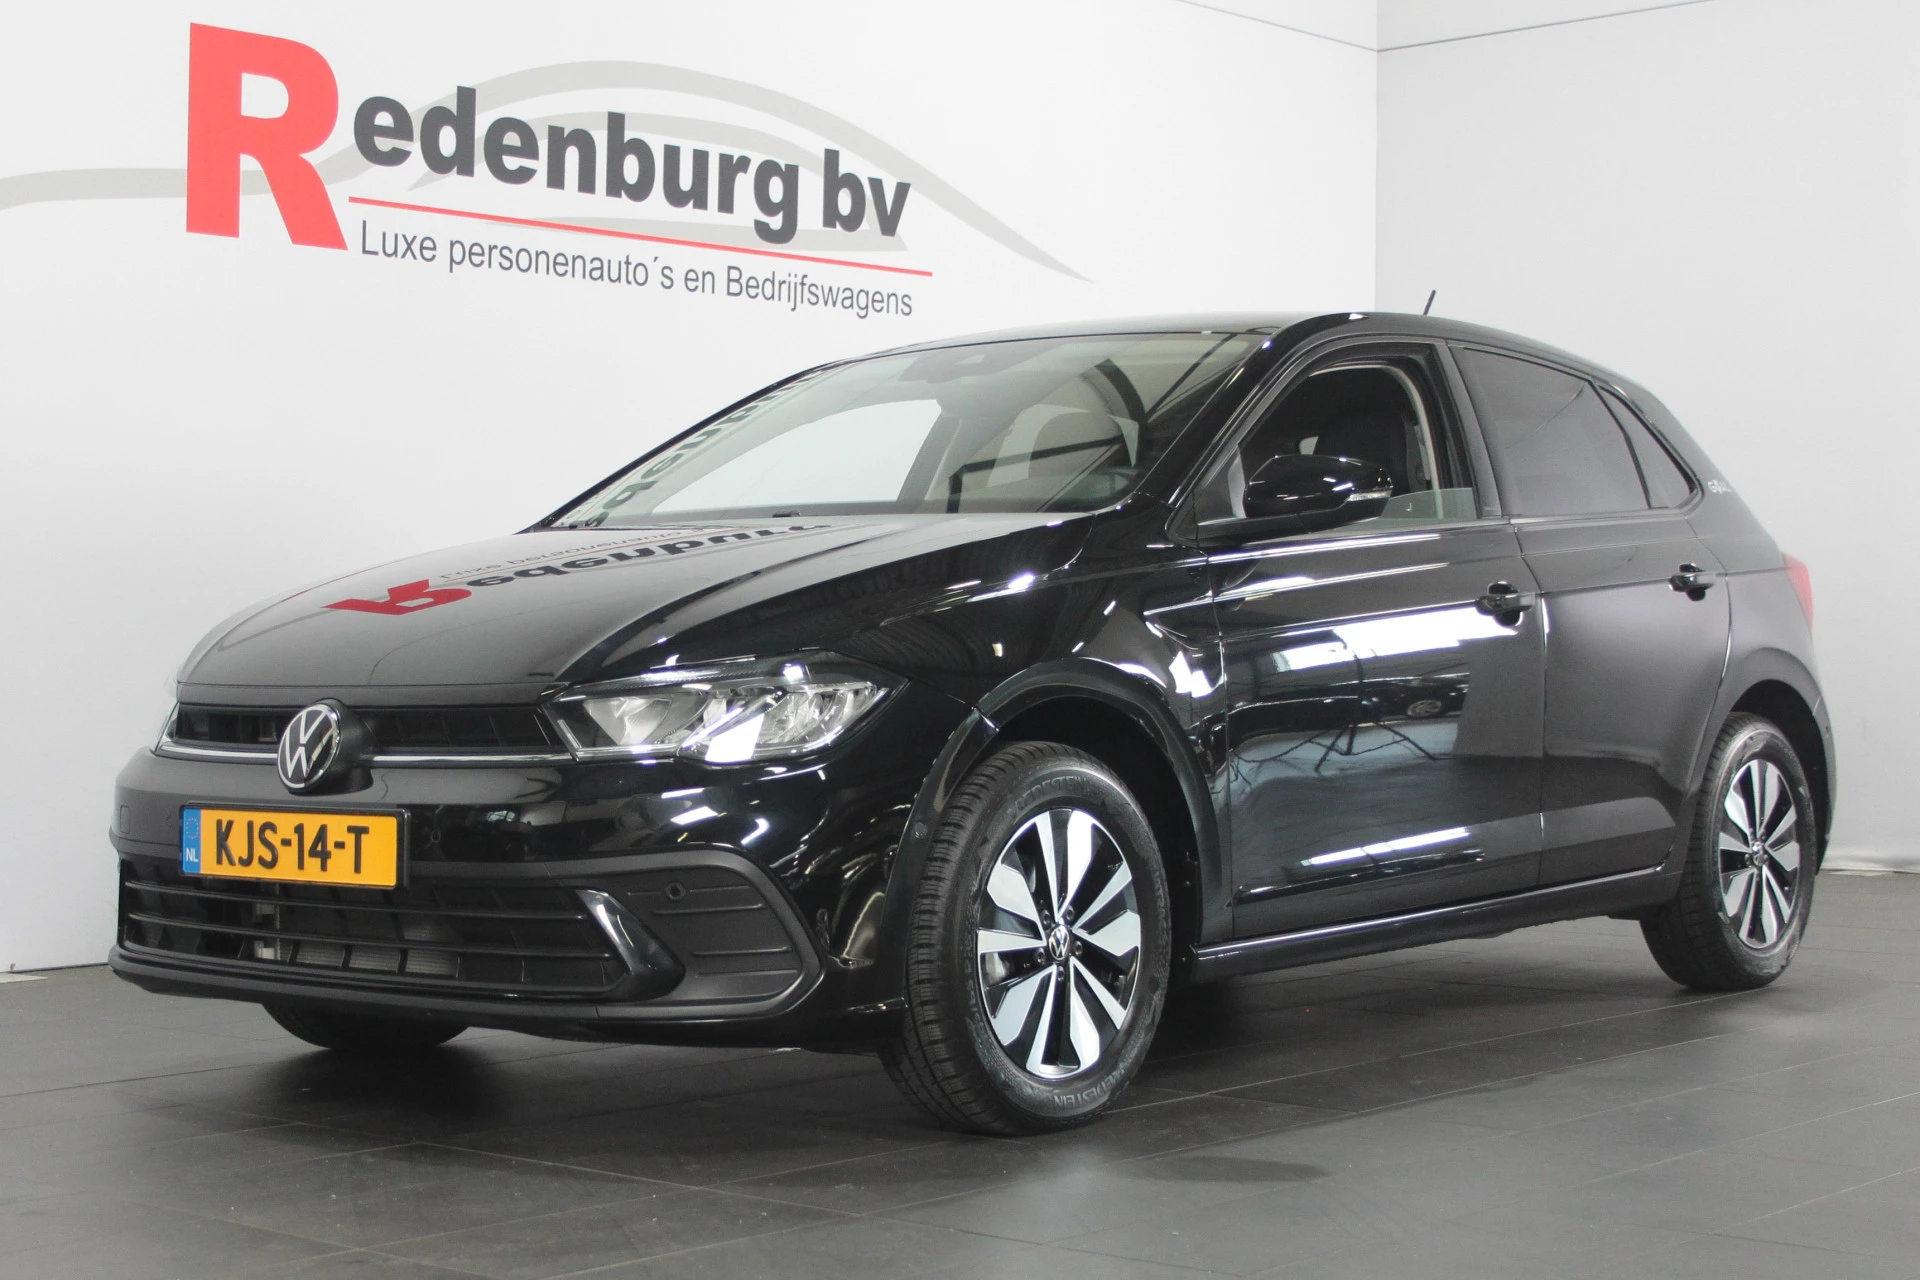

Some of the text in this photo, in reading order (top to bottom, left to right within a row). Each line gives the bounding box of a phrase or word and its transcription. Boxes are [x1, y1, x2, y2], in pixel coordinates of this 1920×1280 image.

[186, 22, 911, 250] Redenburg bv
[361, 219, 437, 262] Luxe
[684, 268, 716, 294] en
[726, 265, 913, 319] Bedrijfswagens
[185, 847, 199, 863] NL
[215, 818, 370, 874] KJS-14-T
